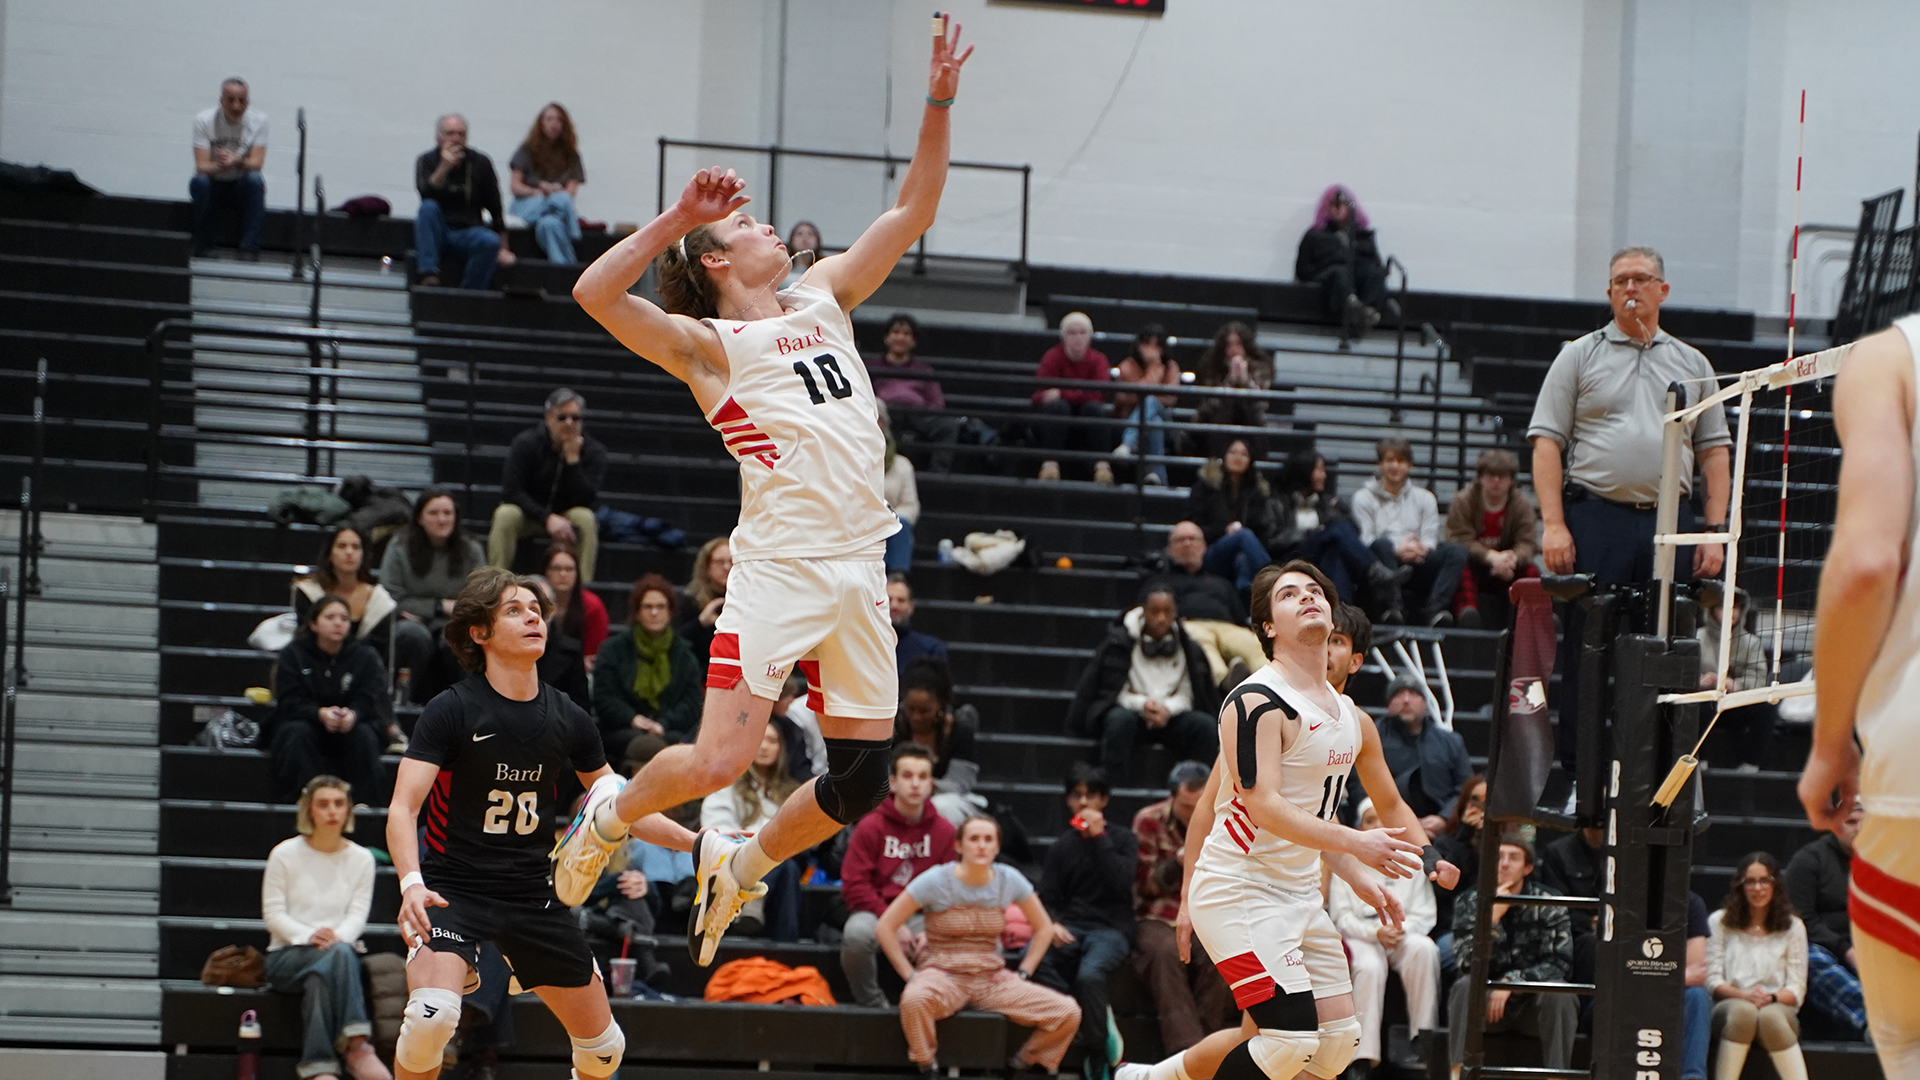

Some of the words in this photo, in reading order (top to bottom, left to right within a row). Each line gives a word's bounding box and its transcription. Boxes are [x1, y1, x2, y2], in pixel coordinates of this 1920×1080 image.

[775, 326, 827, 356] Bard
[793, 353, 852, 405] 10
[766, 663, 785, 679] Bar
[1327, 745, 1353, 766] Bard
[494, 763, 543, 782] Bard
[483, 788, 540, 835] 20
[1316, 774, 1344, 820] 11
[1603, 759, 1621, 942] BARD
[1284, 954, 1304, 966] Ba
